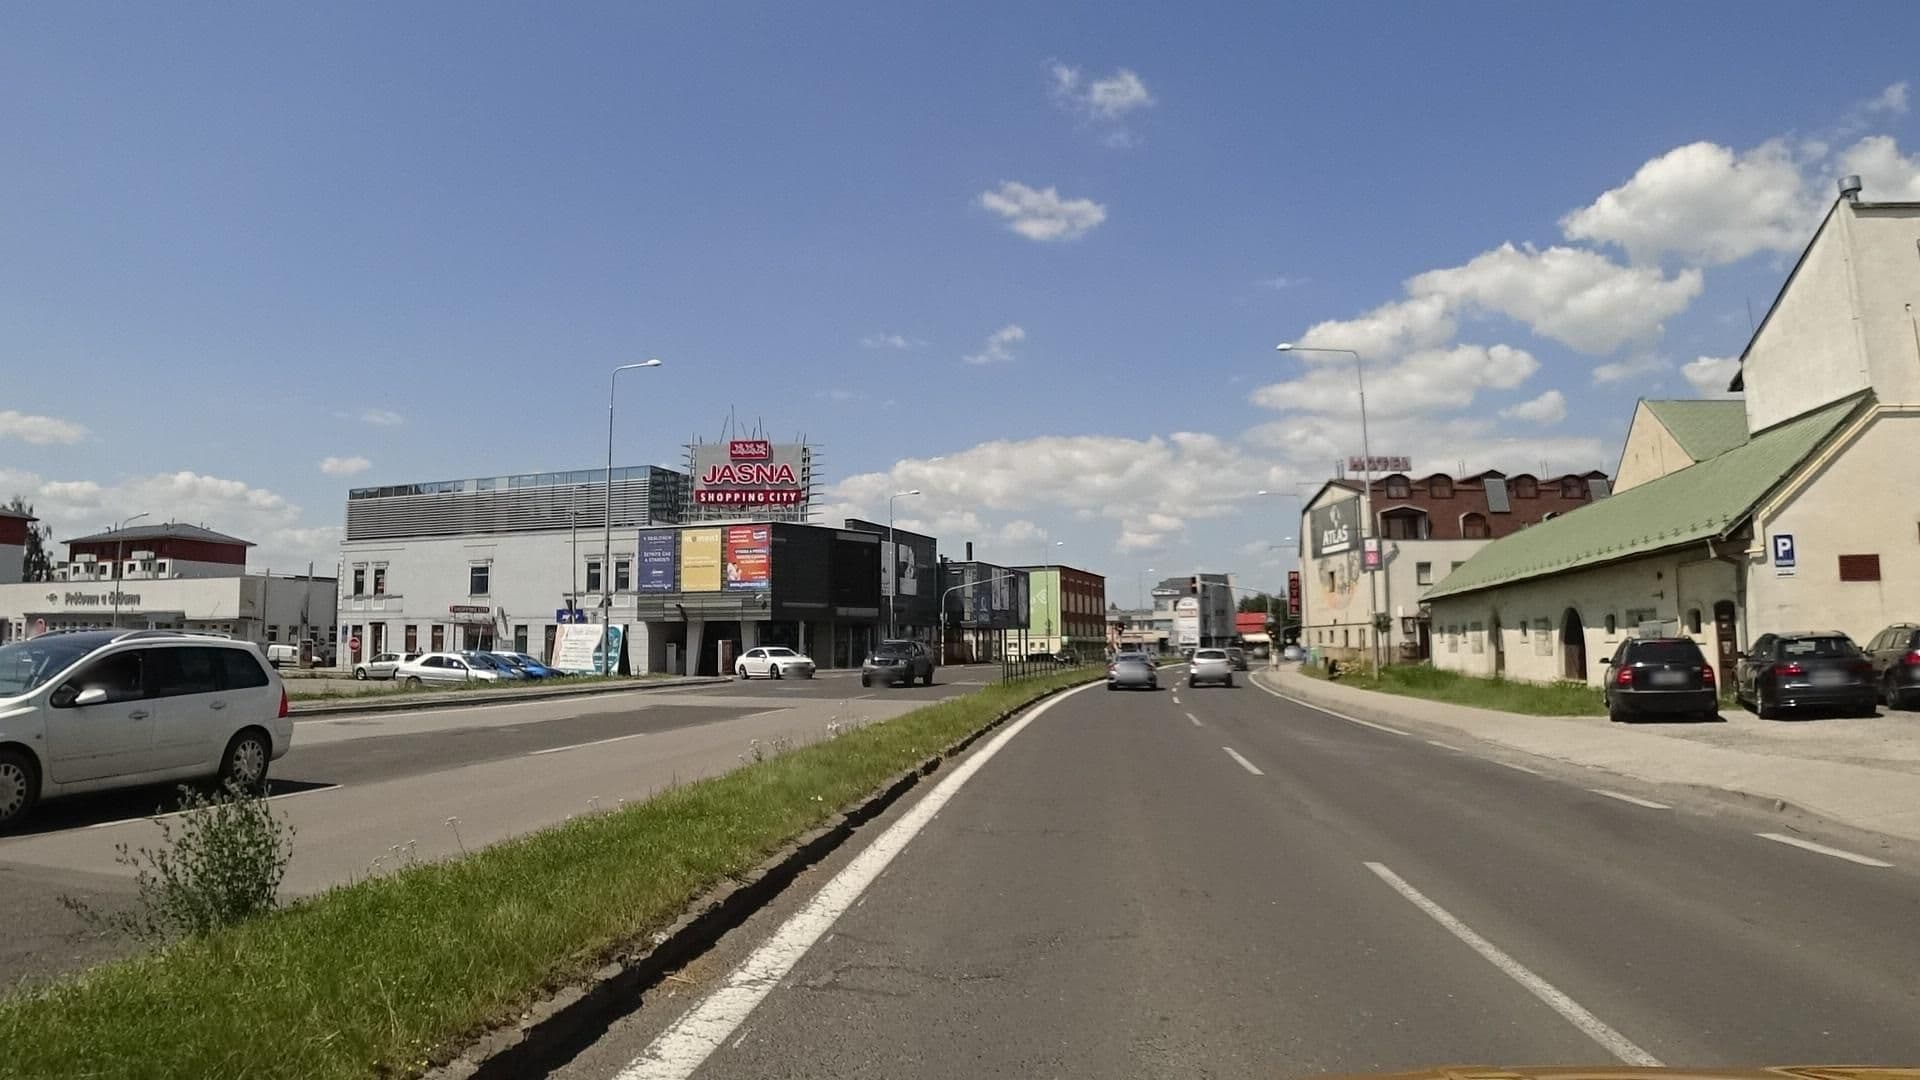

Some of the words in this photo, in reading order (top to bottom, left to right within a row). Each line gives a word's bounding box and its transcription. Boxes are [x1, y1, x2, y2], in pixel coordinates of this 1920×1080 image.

[702, 463, 797, 484] JASNA
[700, 492, 765, 502] SHOPPING
[769, 492, 797, 502] CITY
[1322, 524, 1349, 546] ATLAS
[1777, 538, 1791, 558] P
